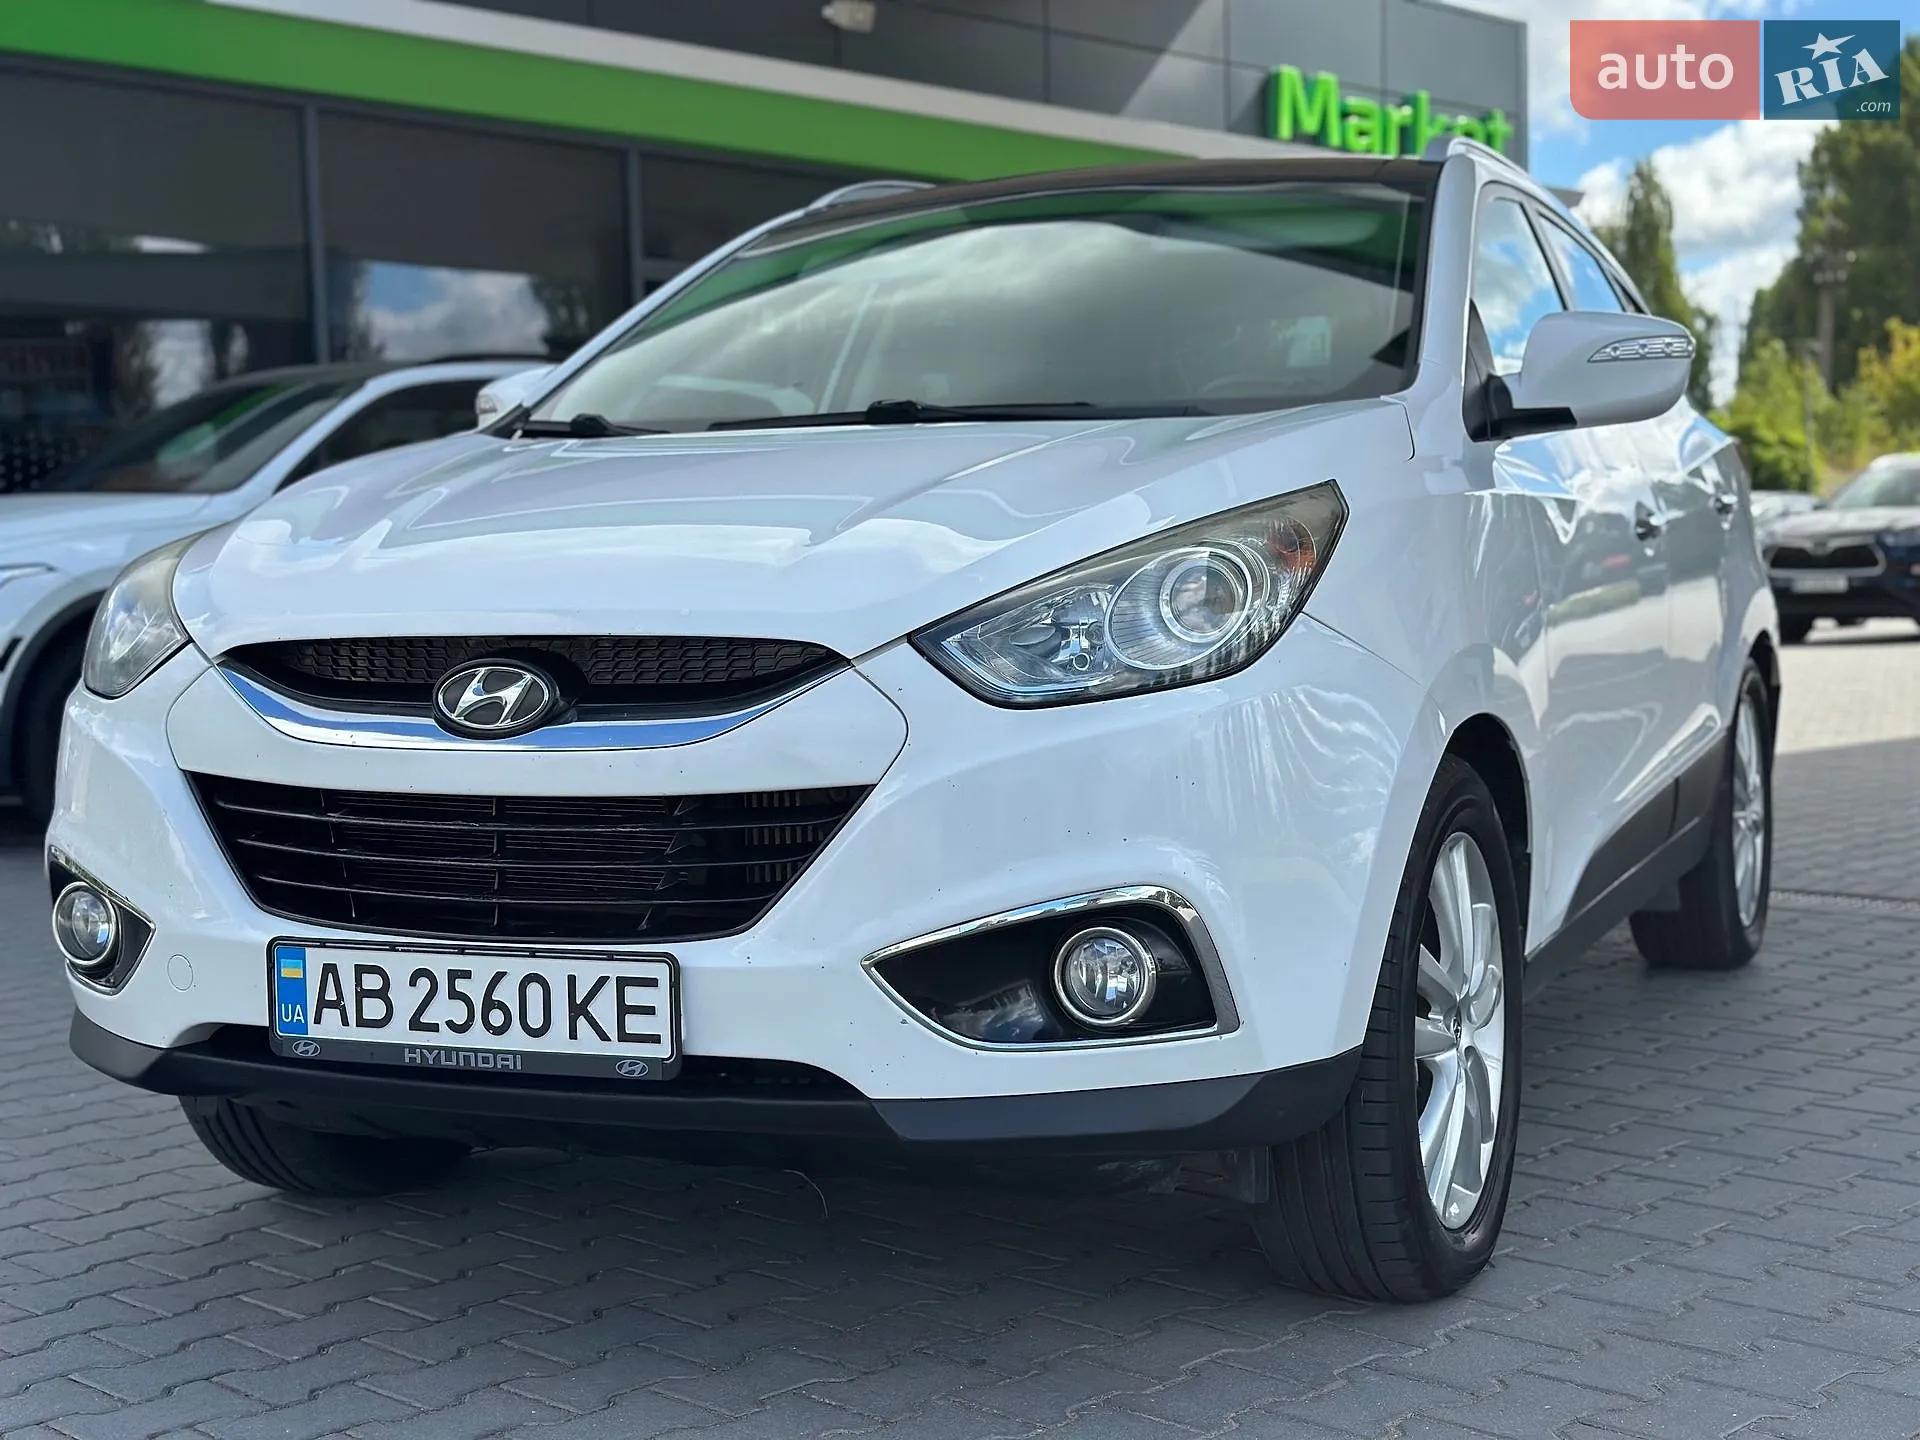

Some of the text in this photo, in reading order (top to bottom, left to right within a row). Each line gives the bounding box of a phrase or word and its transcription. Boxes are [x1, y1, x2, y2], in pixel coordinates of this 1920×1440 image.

[281, 1004, 305, 1024] UA
[313, 962, 661, 1044] AB 2560 KE
[404, 1047, 522, 1071] HYUNDAI
